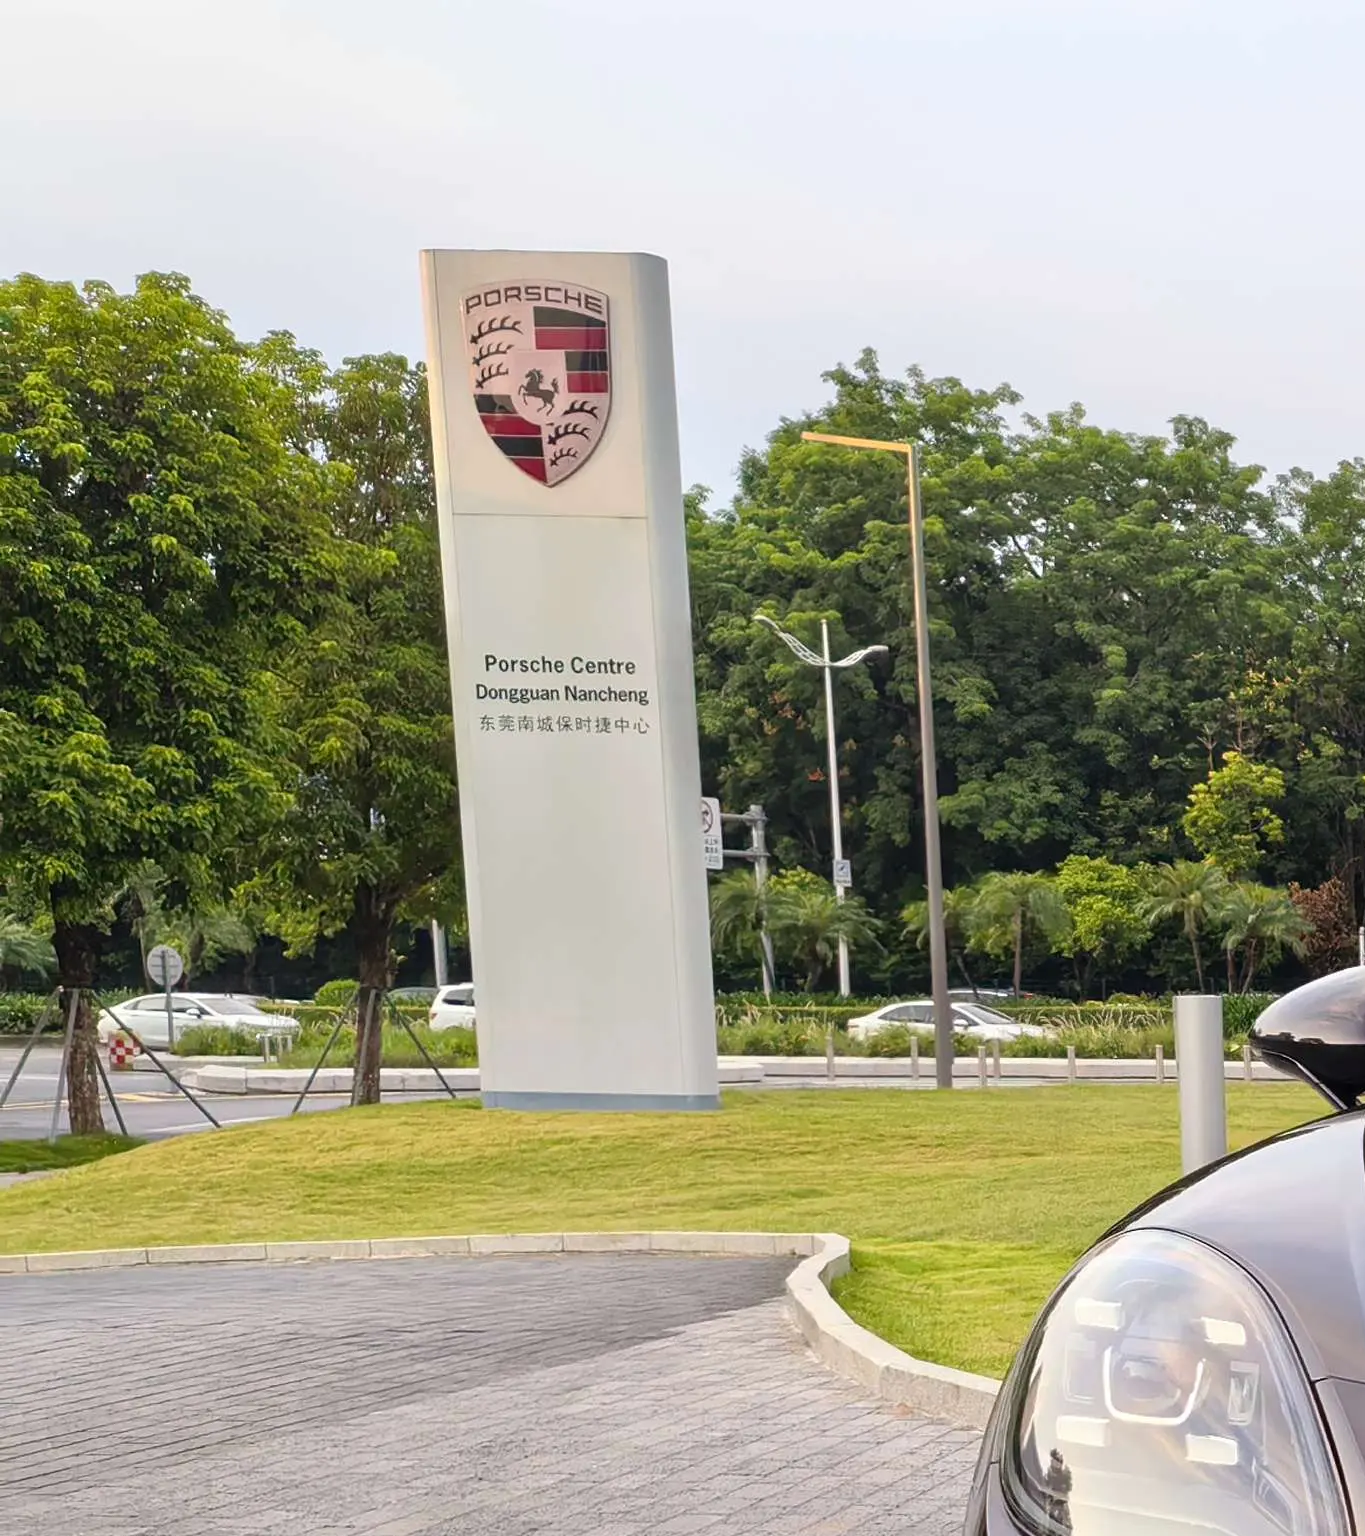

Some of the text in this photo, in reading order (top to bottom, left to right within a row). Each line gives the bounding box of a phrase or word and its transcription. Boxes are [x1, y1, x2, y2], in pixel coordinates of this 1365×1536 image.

[465, 286, 603, 314] PORSCHE
[484, 654, 636, 675] Porsche Centre
[475, 683, 650, 706] Dongguan Nancheng
[479, 714, 650, 735] 东莞南城保时捷中心
